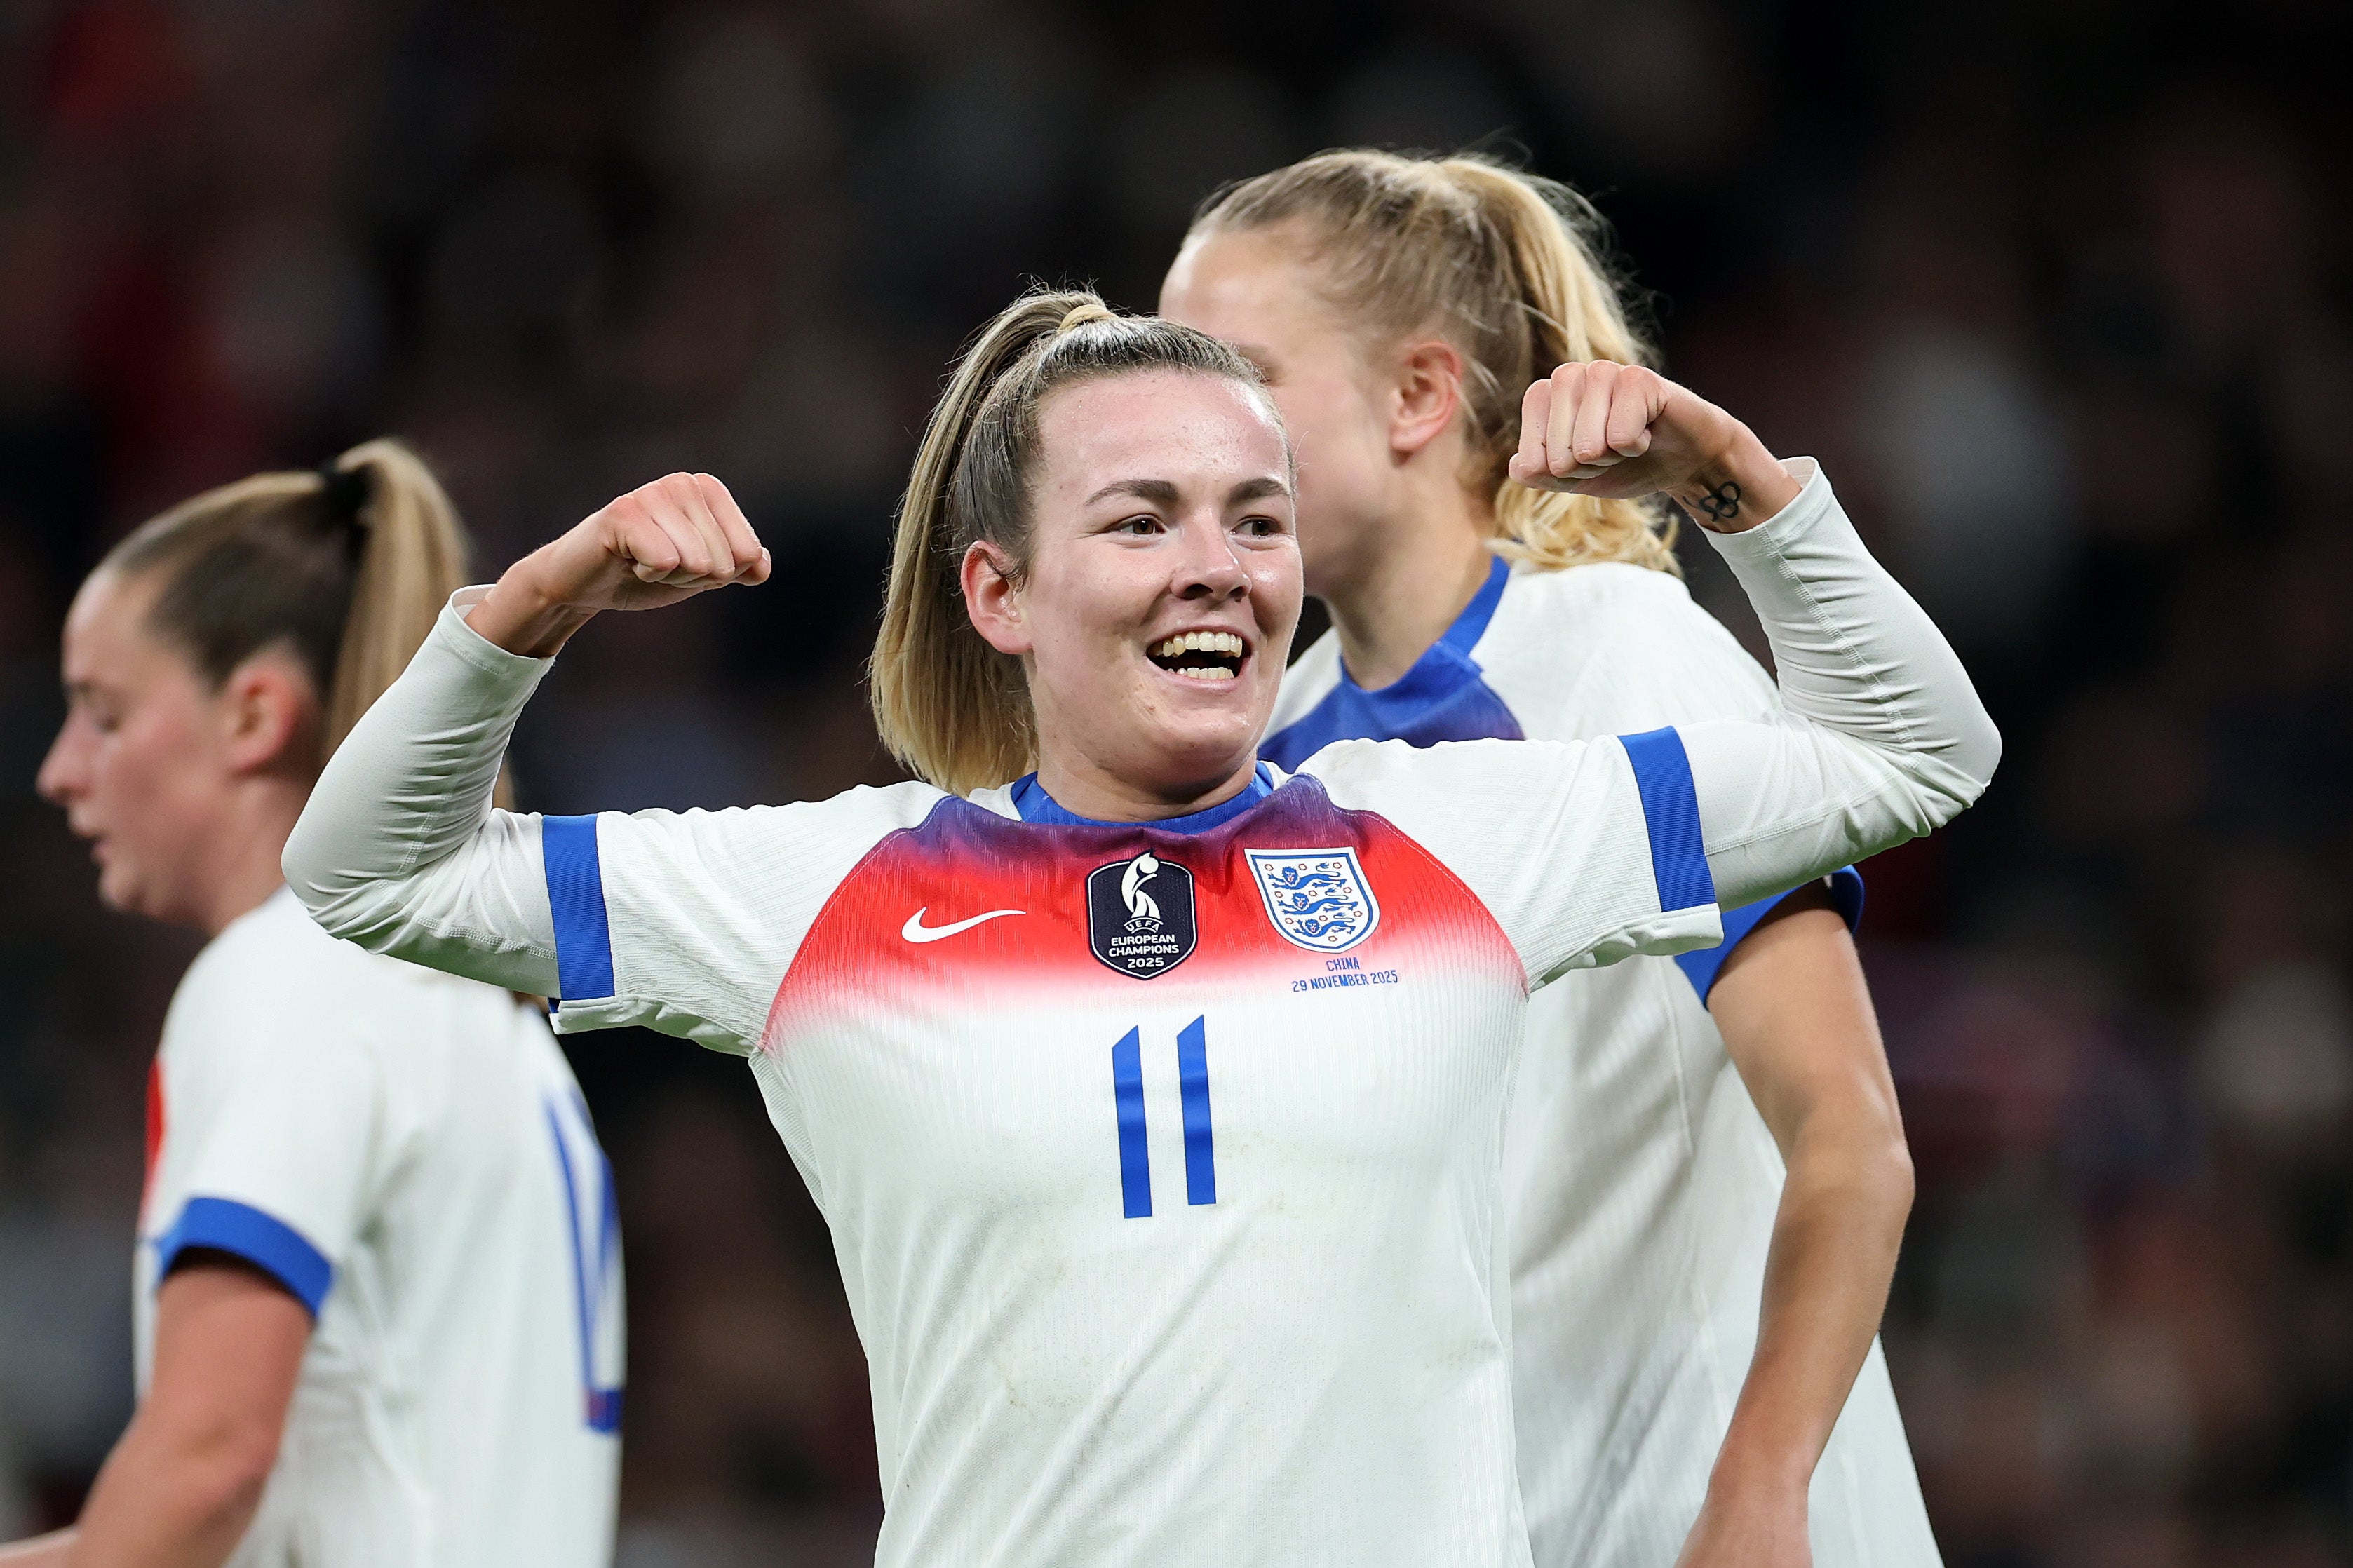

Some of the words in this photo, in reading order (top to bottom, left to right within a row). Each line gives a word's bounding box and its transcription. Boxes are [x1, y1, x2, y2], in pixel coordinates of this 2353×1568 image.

[1125, 919, 1161, 933] UEFA
[1111, 934, 1175, 946] EUROPEAN
[1108, 944, 1180, 957] CHAMPIONS
[1127, 957, 1164, 968] 2025
[1326, 957, 1360, 971] CHINA
[1292, 980, 1308, 992] 29
[1309, 973, 1369, 989] NOVEMBER
[1370, 970, 1398, 985] 2025
[1112, 1014, 1216, 1219] 11
